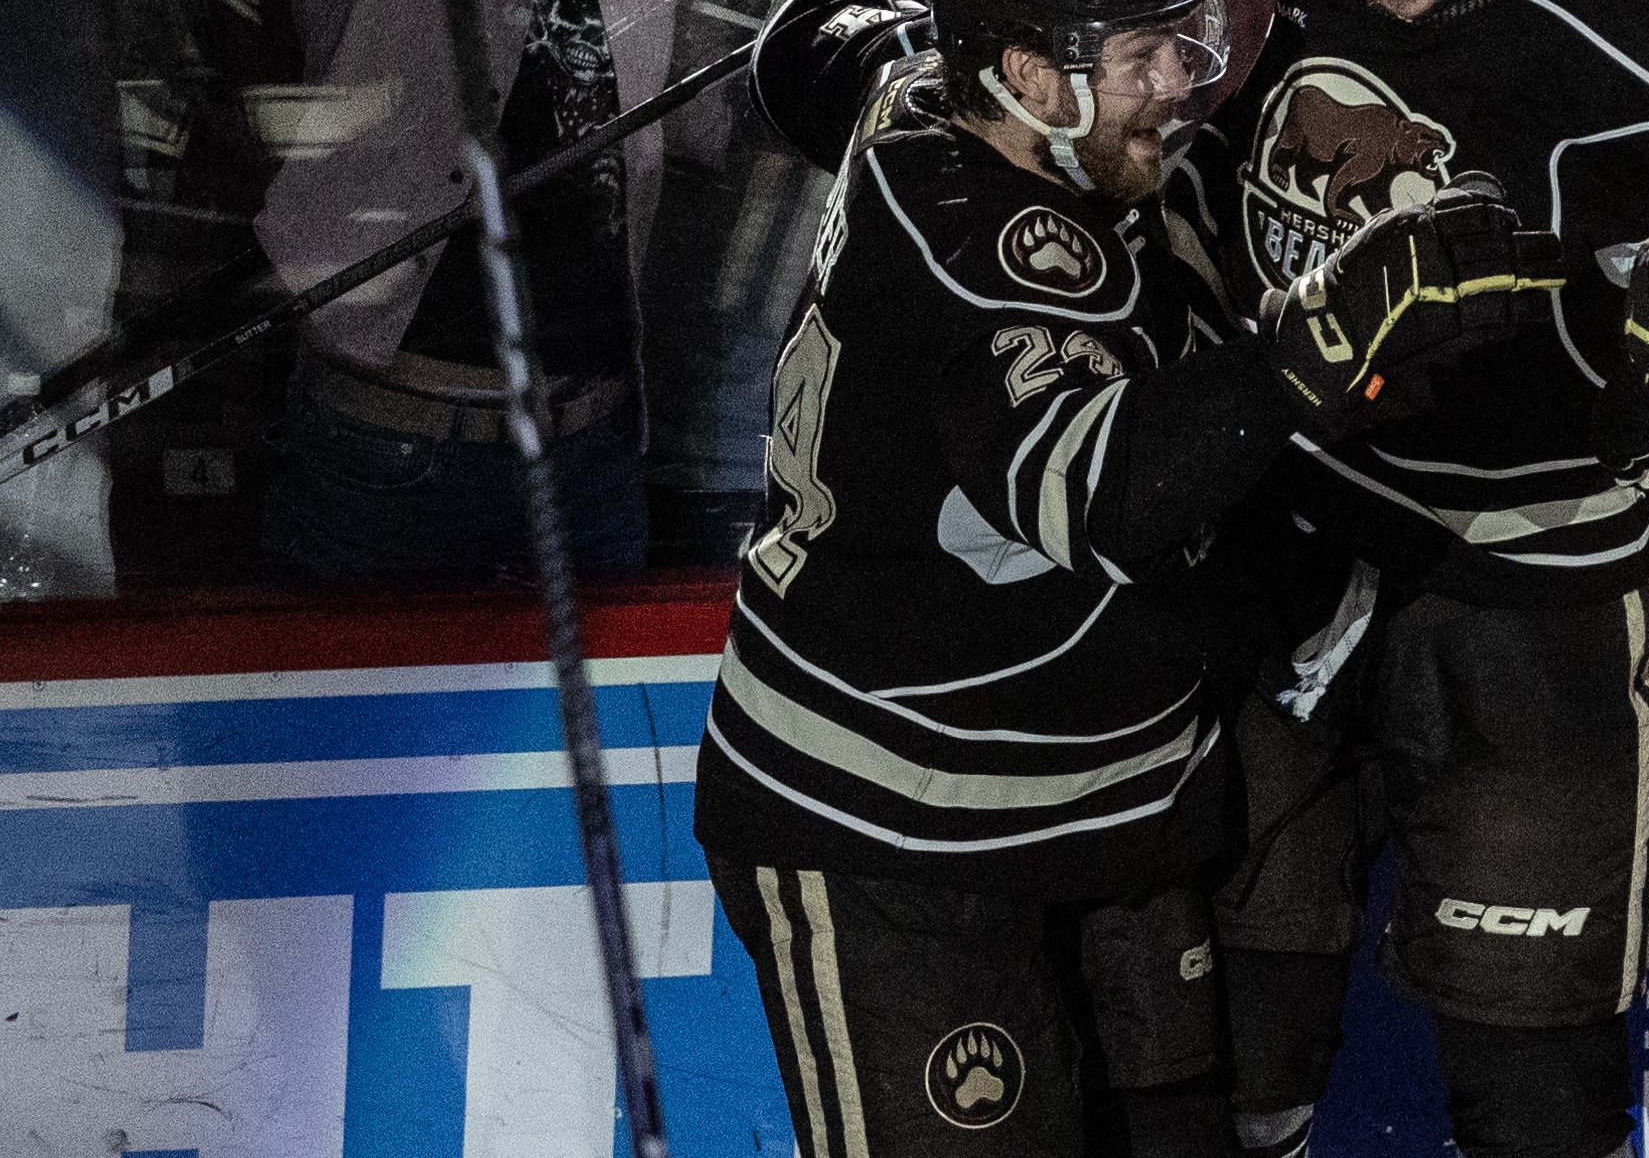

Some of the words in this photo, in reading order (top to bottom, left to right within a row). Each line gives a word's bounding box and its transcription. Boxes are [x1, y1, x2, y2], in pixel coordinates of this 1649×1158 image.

[1280, 208, 1350, 246] HERSH
[234, 319, 272, 344] SUTTER
[1280, 367, 1323, 407] HERSHEY
[1435, 898, 1591, 938] CCM
[1179, 939, 1213, 982] C
